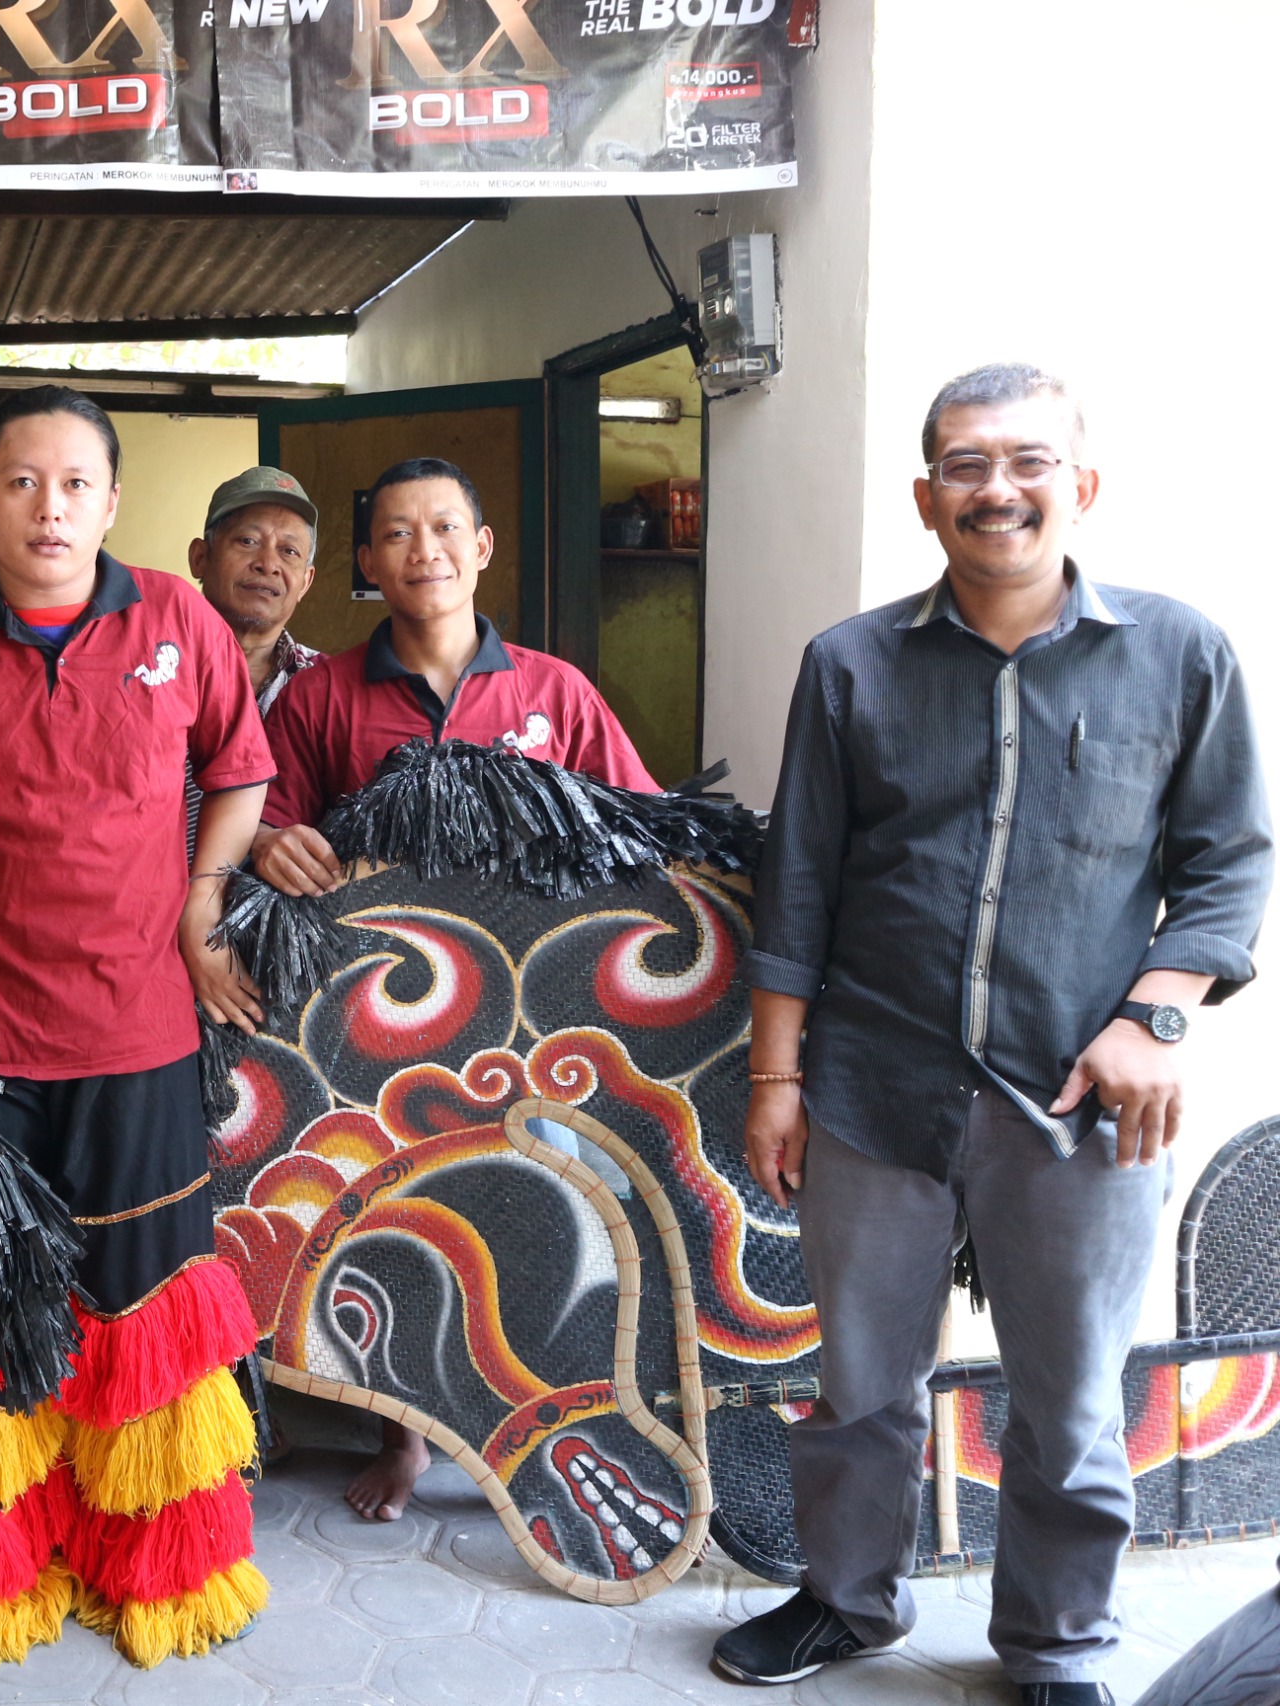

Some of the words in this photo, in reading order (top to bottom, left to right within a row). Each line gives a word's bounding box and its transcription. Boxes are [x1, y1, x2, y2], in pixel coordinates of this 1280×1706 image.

[229, 0, 330, 28] NEW
[585, 0, 630, 19] THE
[580, 16, 634, 37] REAL
[369, 89, 530, 131] BOLD
[666, 126, 708, 149] 20
[712, 122, 761, 136] FILTER
[712, 133, 761, 146] KRETEK
[30, 171, 94, 181] PERINGATAN
[102, 170, 153, 180] MEROKOK
[489, 179, 536, 189] MEROKOK
[539, 179, 607, 189] MEMBUNUHMU
